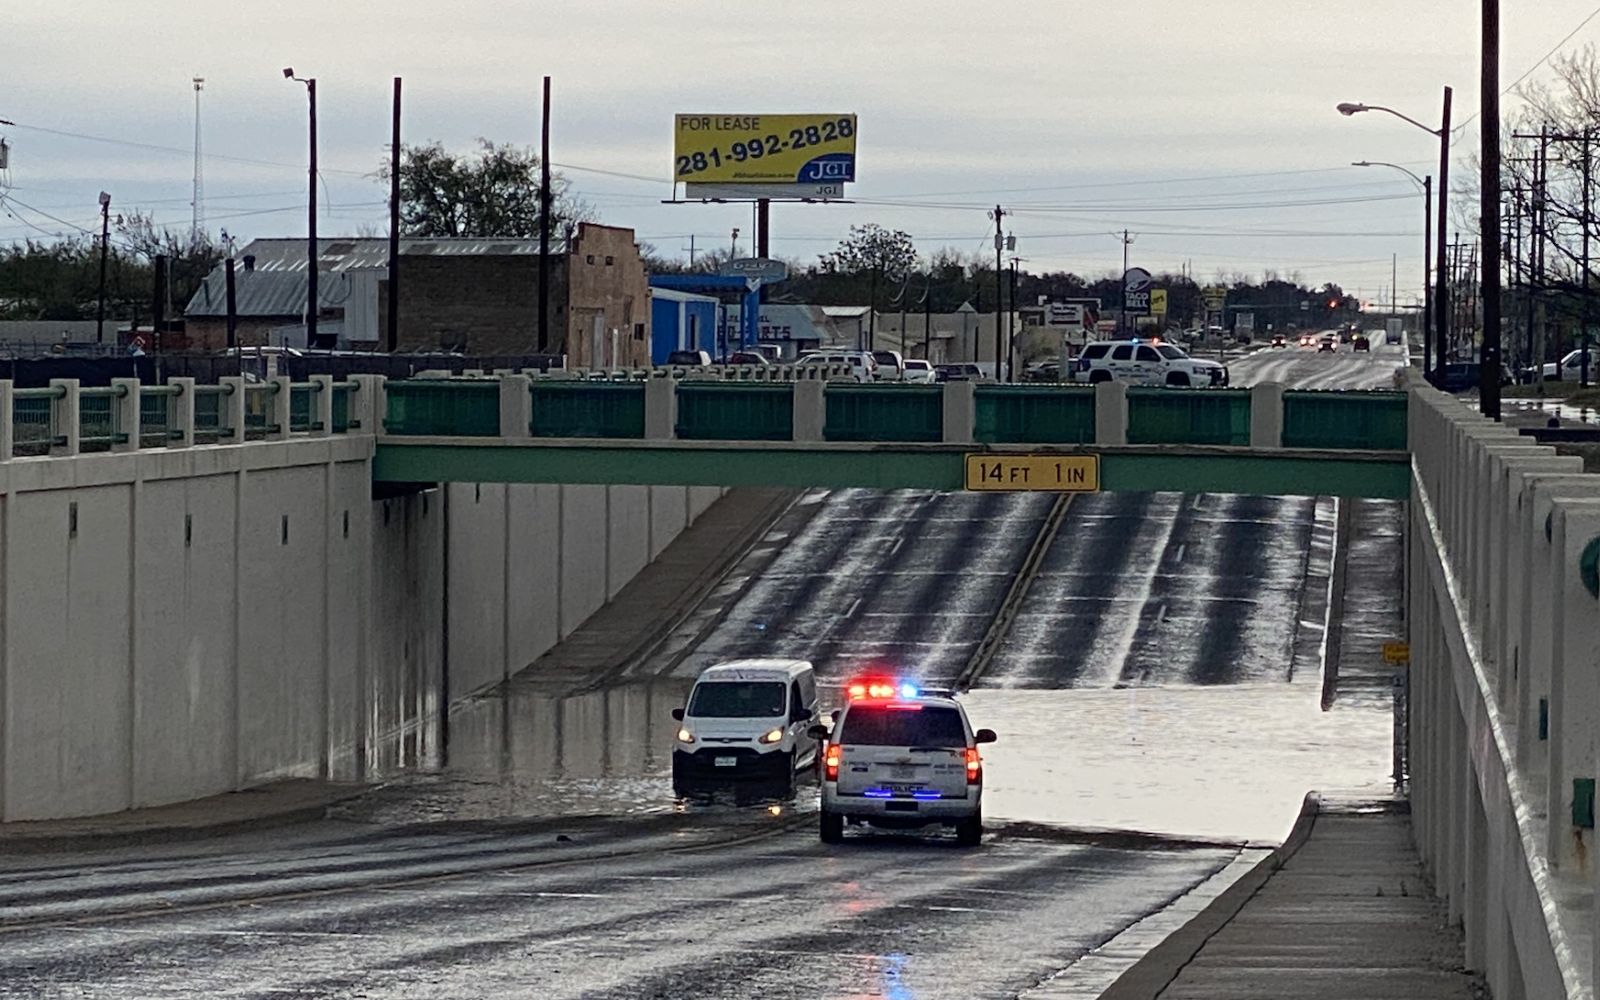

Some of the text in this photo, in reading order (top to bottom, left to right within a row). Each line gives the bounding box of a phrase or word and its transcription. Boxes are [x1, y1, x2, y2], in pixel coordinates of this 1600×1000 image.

[680, 117, 761, 131] FOR LEASE
[677, 118, 854, 176] 281-992-2828
[809, 160, 851, 180] JGI
[815, 186, 838, 195] JGI
[1124, 292, 1149, 300] TACO
[1125, 299, 1149, 308] BELL
[980, 462, 1085, 483] 14 FT 1 IN
[881, 785, 925, 793] POLICE
